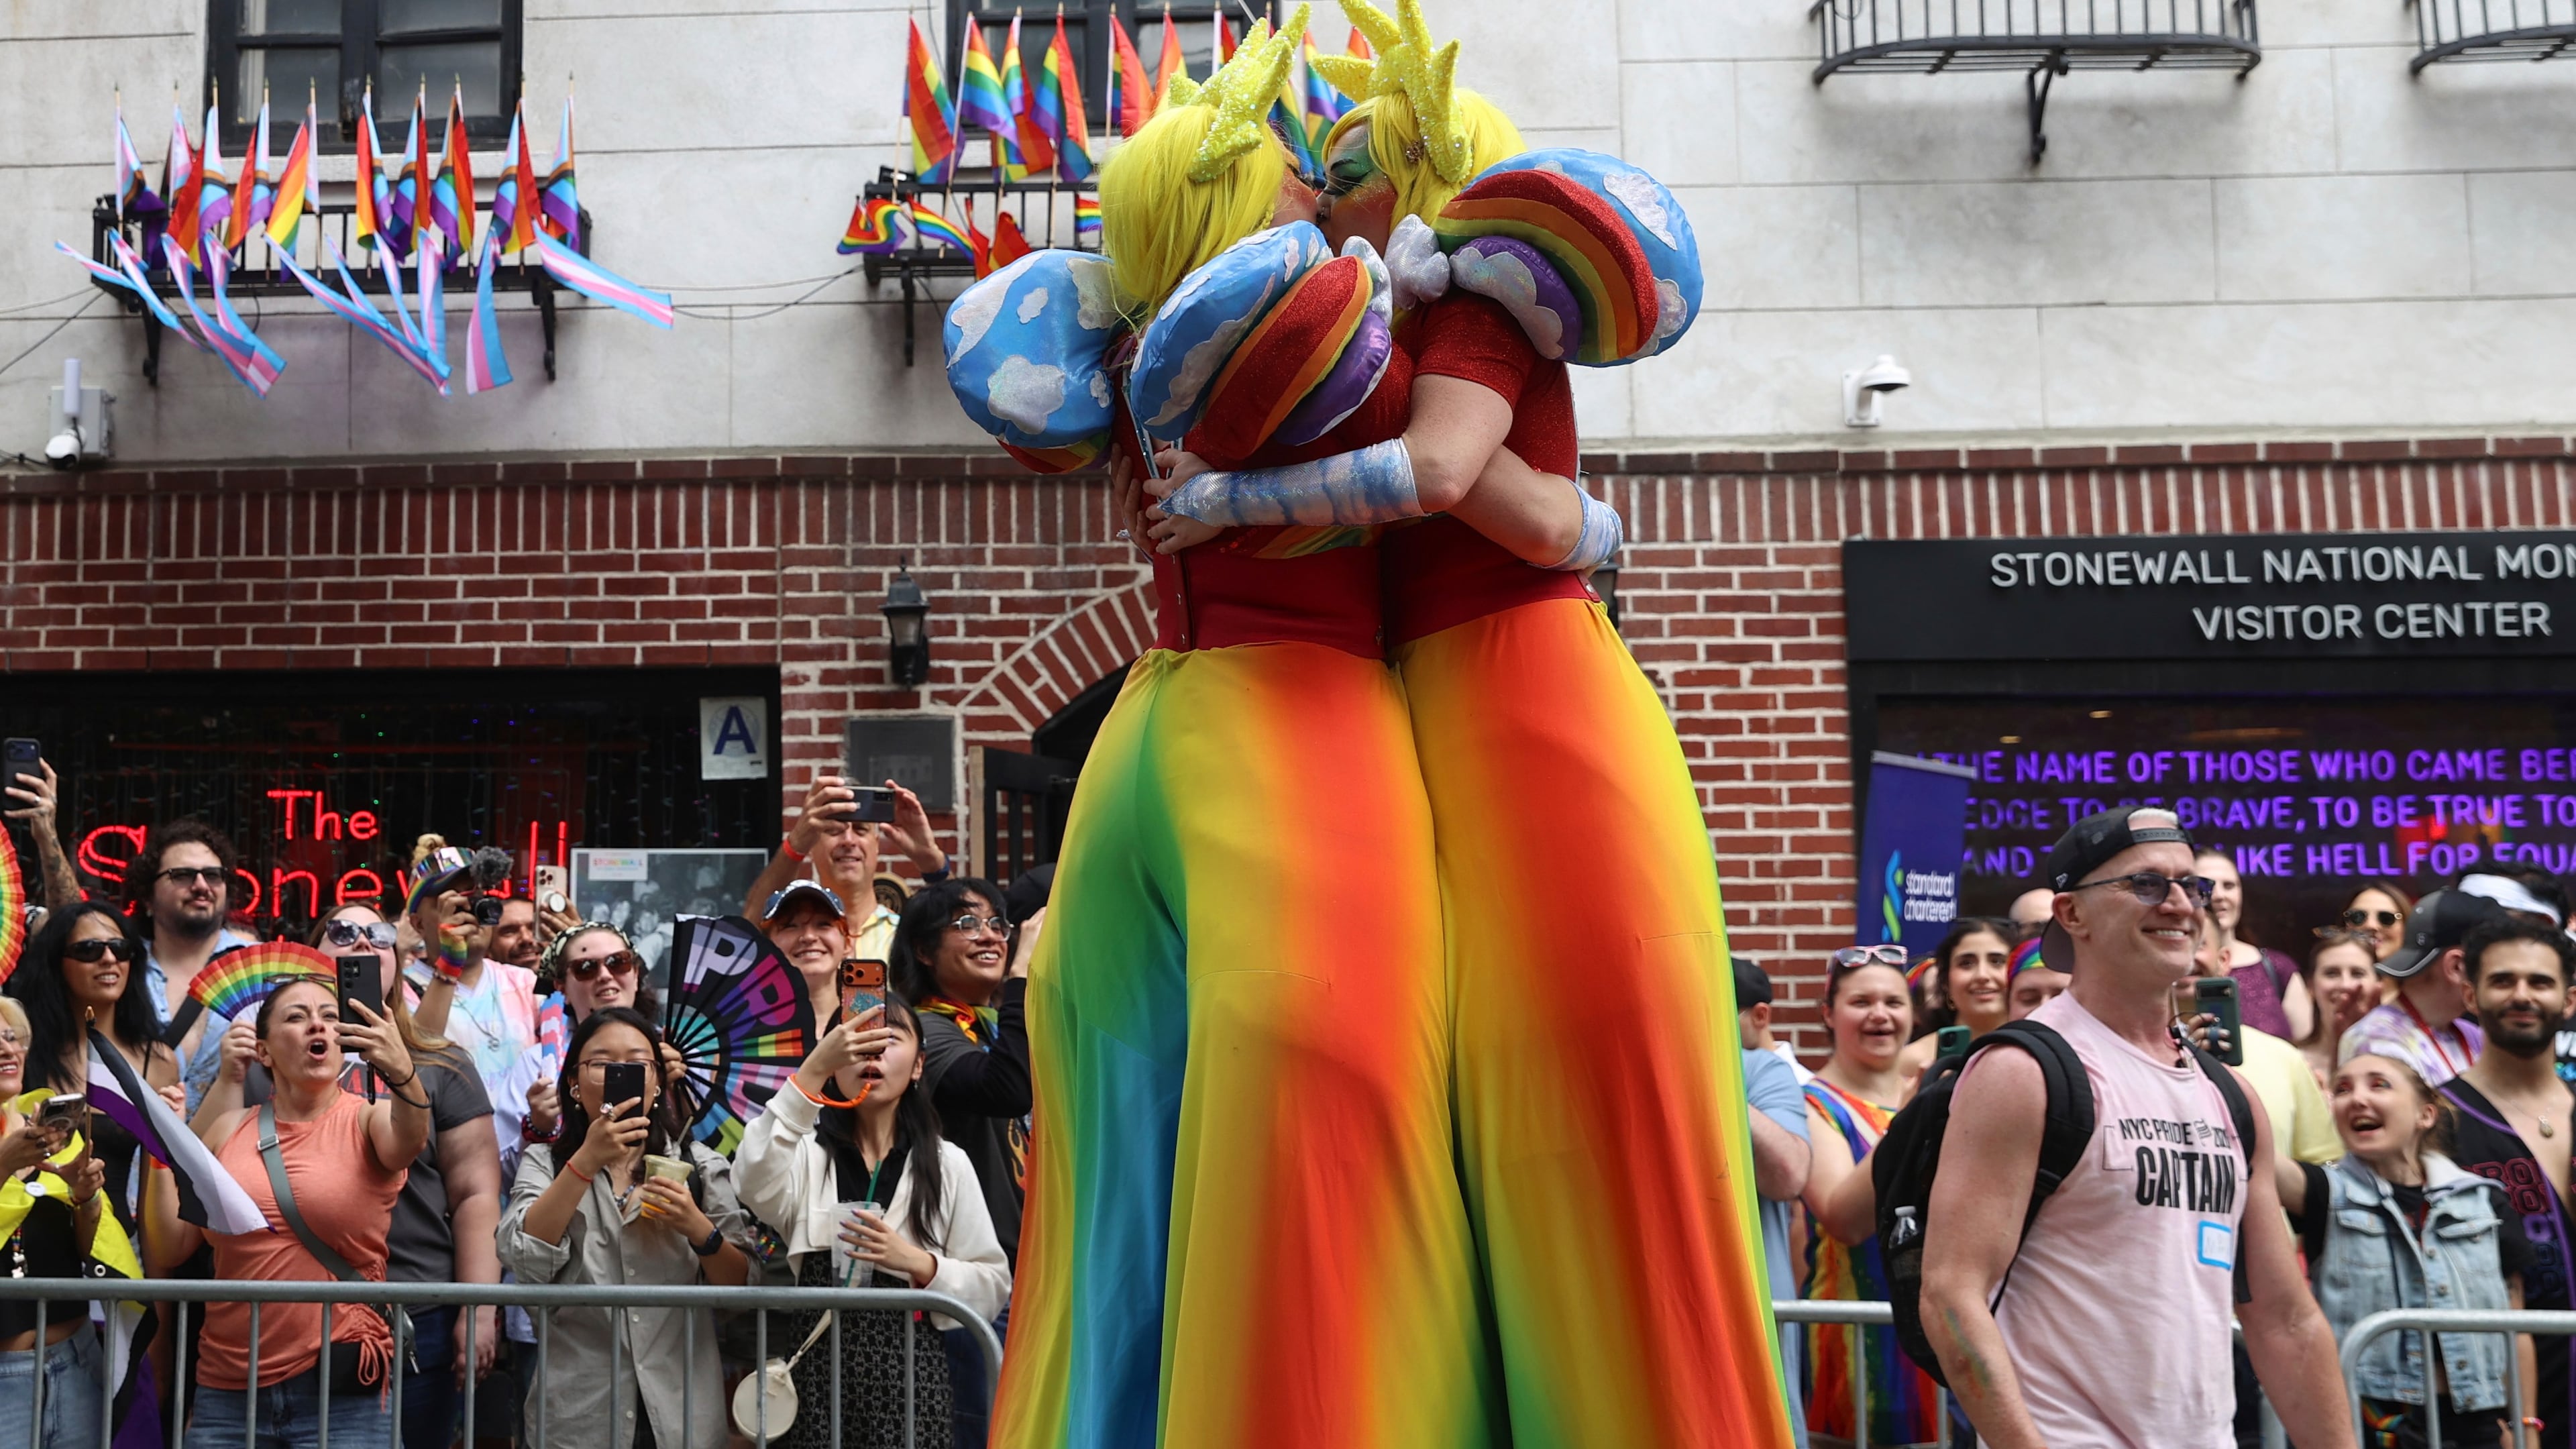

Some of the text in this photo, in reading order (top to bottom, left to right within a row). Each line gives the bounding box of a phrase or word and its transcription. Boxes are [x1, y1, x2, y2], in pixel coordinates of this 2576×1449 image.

[1991, 550, 2252, 587] STONEWALL
[2262, 545, 2485, 584] NATIONAL
[2192, 602, 2553, 641] VISITOR CENTER
[712, 705, 757, 755] A
[2015, 751, 2116, 784] NAME
[2127, 750, 2175, 784] OF
[2180, 749, 2301, 784] THOSE
[2309, 749, 2396, 781] WHO
[2406, 749, 2507, 781] CAME
[267, 790, 378, 840] The
[1964, 798, 2051, 830] EDGE
[2176, 794, 2576, 833] BRAVE, TO BE TRUE TO
[1963, 846, 2035, 877] AND
[2236, 843, 2295, 877] IKE
[2306, 842, 2402, 875] HELL
[1905, 869, 1955, 898] standard
[1904, 896, 1957, 922] chartered
[2118, 1118, 2153, 1140] NYC
[2152, 1119, 2193, 1145] PRIDE
[2135, 1146, 2235, 1214] CAPTAIN
